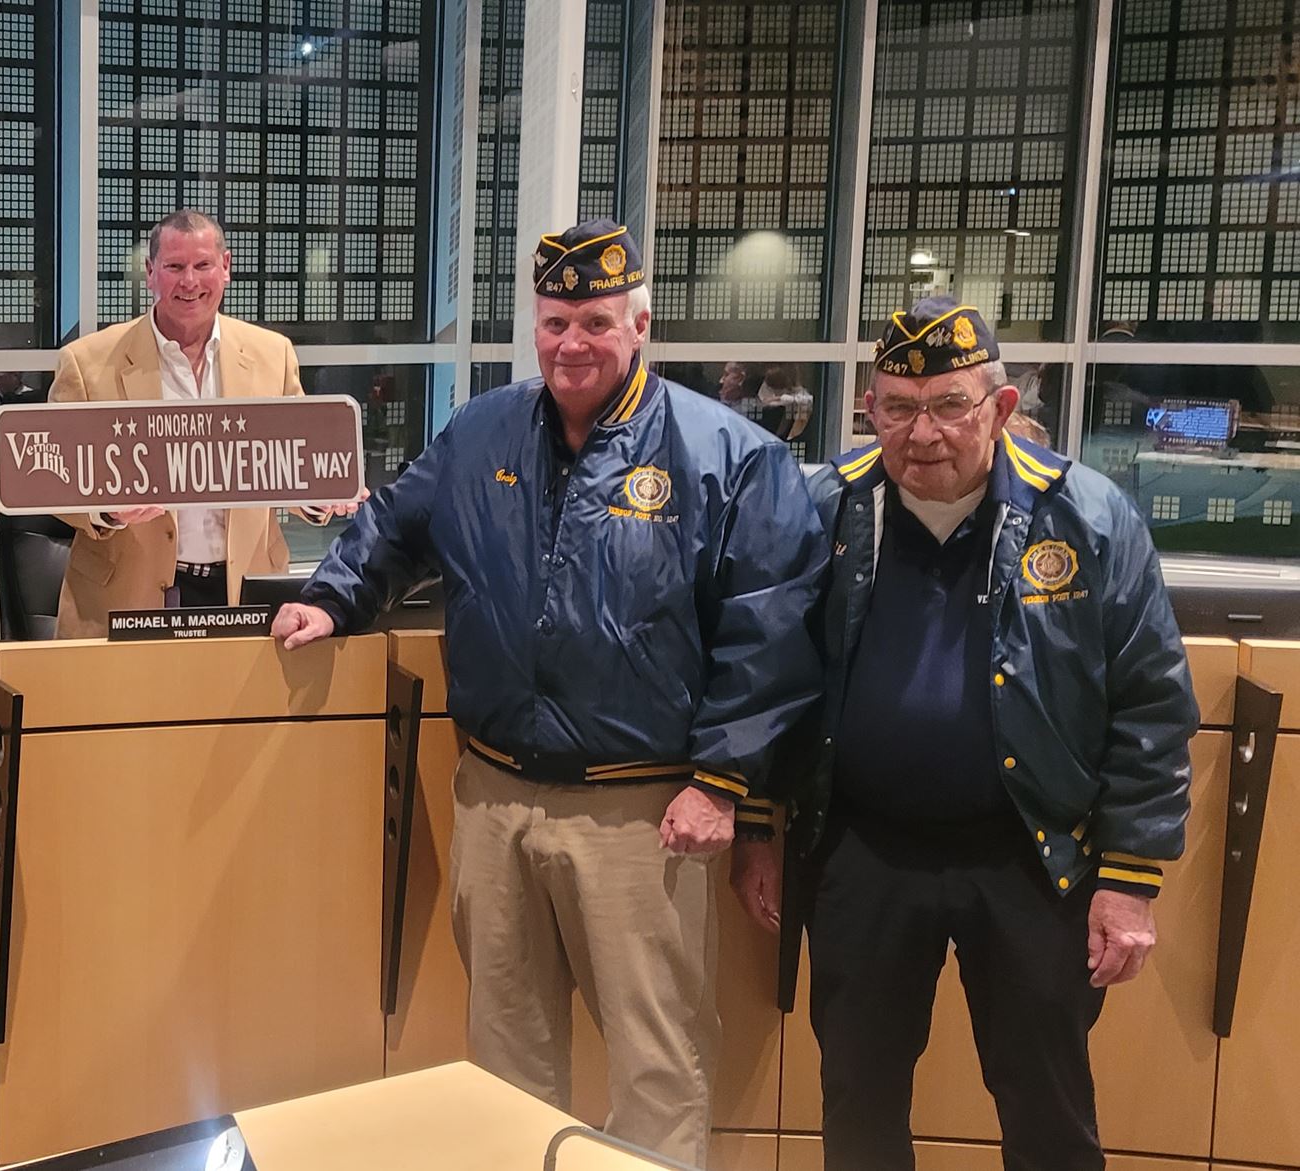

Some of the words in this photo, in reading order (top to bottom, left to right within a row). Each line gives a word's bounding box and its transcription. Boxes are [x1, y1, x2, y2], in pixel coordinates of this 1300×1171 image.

[545, 281, 564, 293] 1247
[589, 274, 625, 291] PRAIRIE
[883, 360, 909, 375] 1247
[951, 348, 990, 369] ILLINOIS
[147, 413, 213, 438] HONORARY
[4, 431, 61, 470] Vernon
[27, 440, 70, 484] Hills
[76, 442, 159, 497] U.S.S.
[165, 439, 309, 493] WOLVERINE
[311, 451, 353, 479] WAY
[112, 616, 169, 630] MICHAEL
[171, 615, 185, 628] M.
[188, 613, 268, 627] MARQUARDT
[174, 630, 207, 638] TRUSTEE
